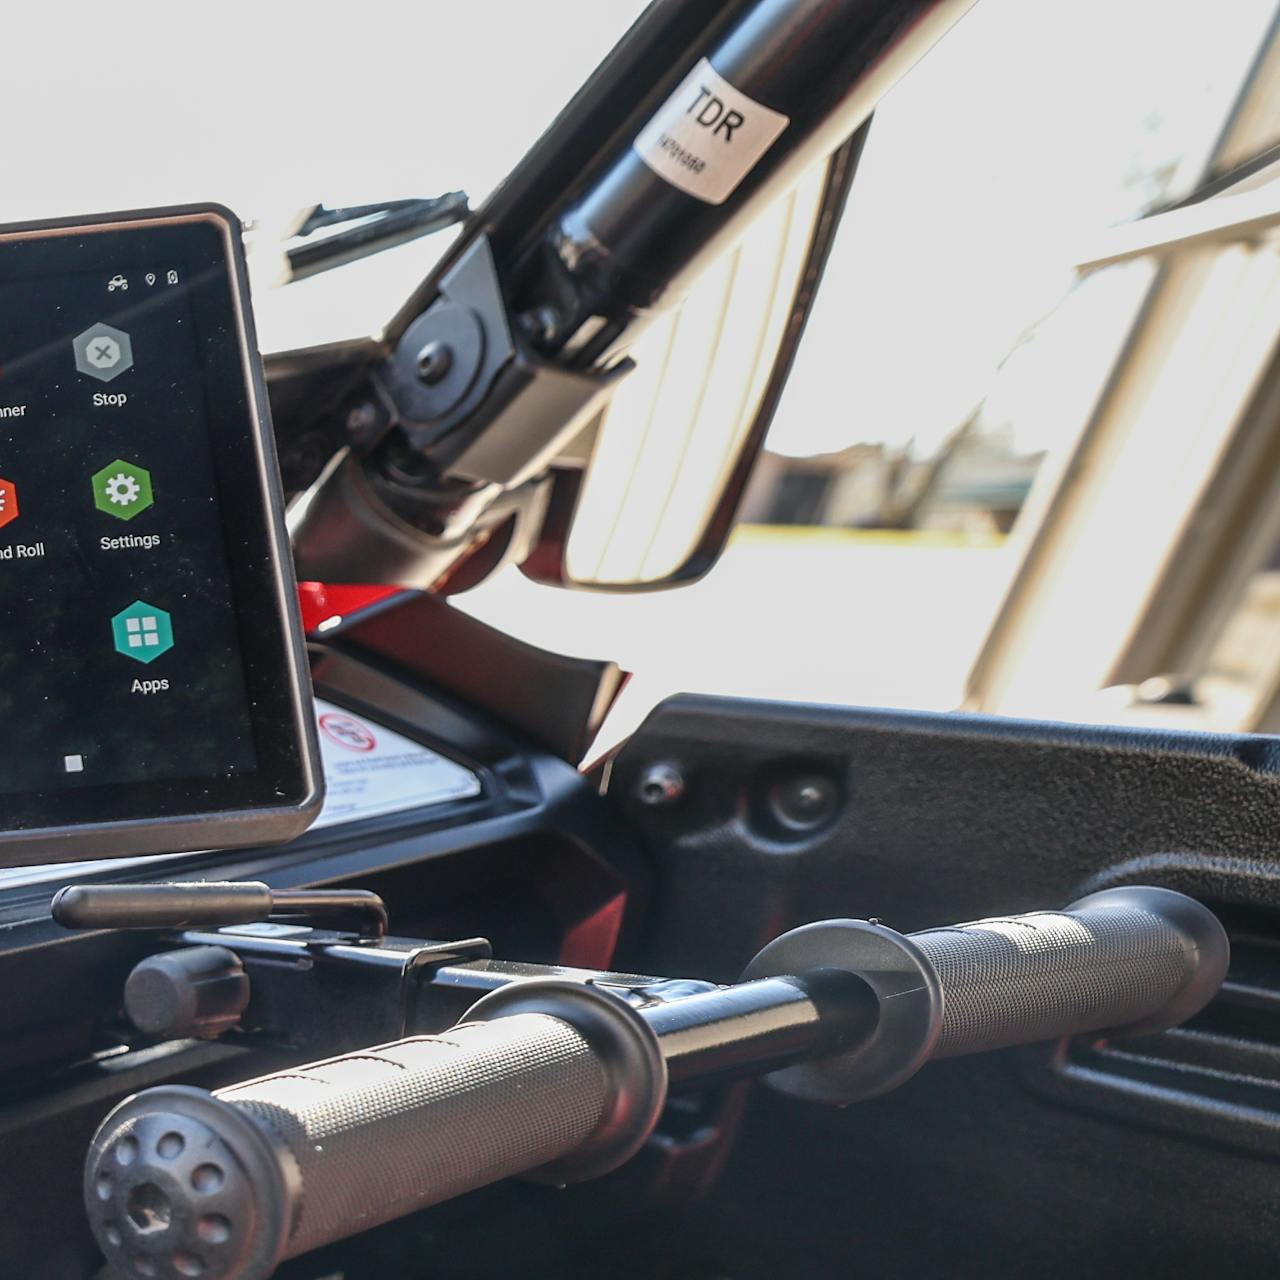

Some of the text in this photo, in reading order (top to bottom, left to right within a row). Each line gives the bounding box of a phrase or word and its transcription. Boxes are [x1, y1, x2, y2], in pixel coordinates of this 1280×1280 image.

[684, 85, 745, 143] TDR
[92, 391, 127, 408] Stop
[17, 541, 45, 558] Roll
[99, 533, 161, 552] Settings
[131, 676, 170, 695] Apps
